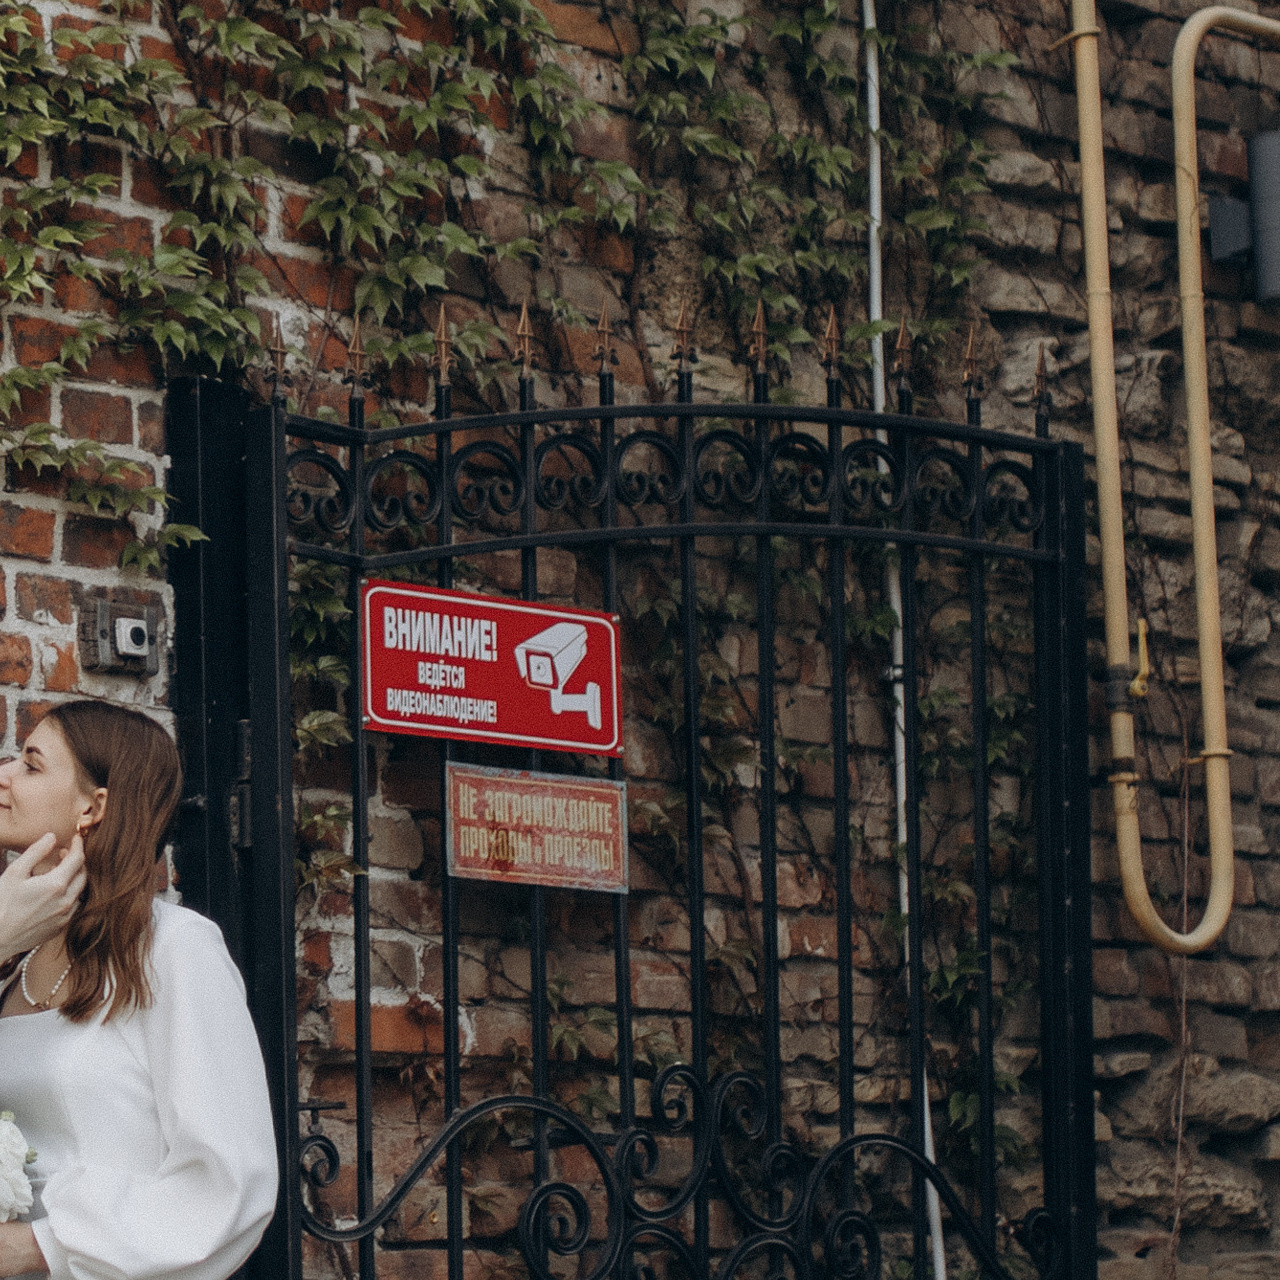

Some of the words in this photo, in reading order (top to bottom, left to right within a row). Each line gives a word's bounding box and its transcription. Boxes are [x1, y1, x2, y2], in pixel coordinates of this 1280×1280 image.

[383, 606, 498, 663] ВНИМАНИЕ!
[386, 687, 498, 724] ВИДЕОНАБЛЮДЕНИЕ!
[458, 782, 478, 821] НЕ
[484, 790, 613, 835] ЗАГРОМОЖДАЙТЕ
[459, 825, 532, 866] ПРОХОДЫ
[543, 833, 614, 871] ПРОЕЗДЫ
